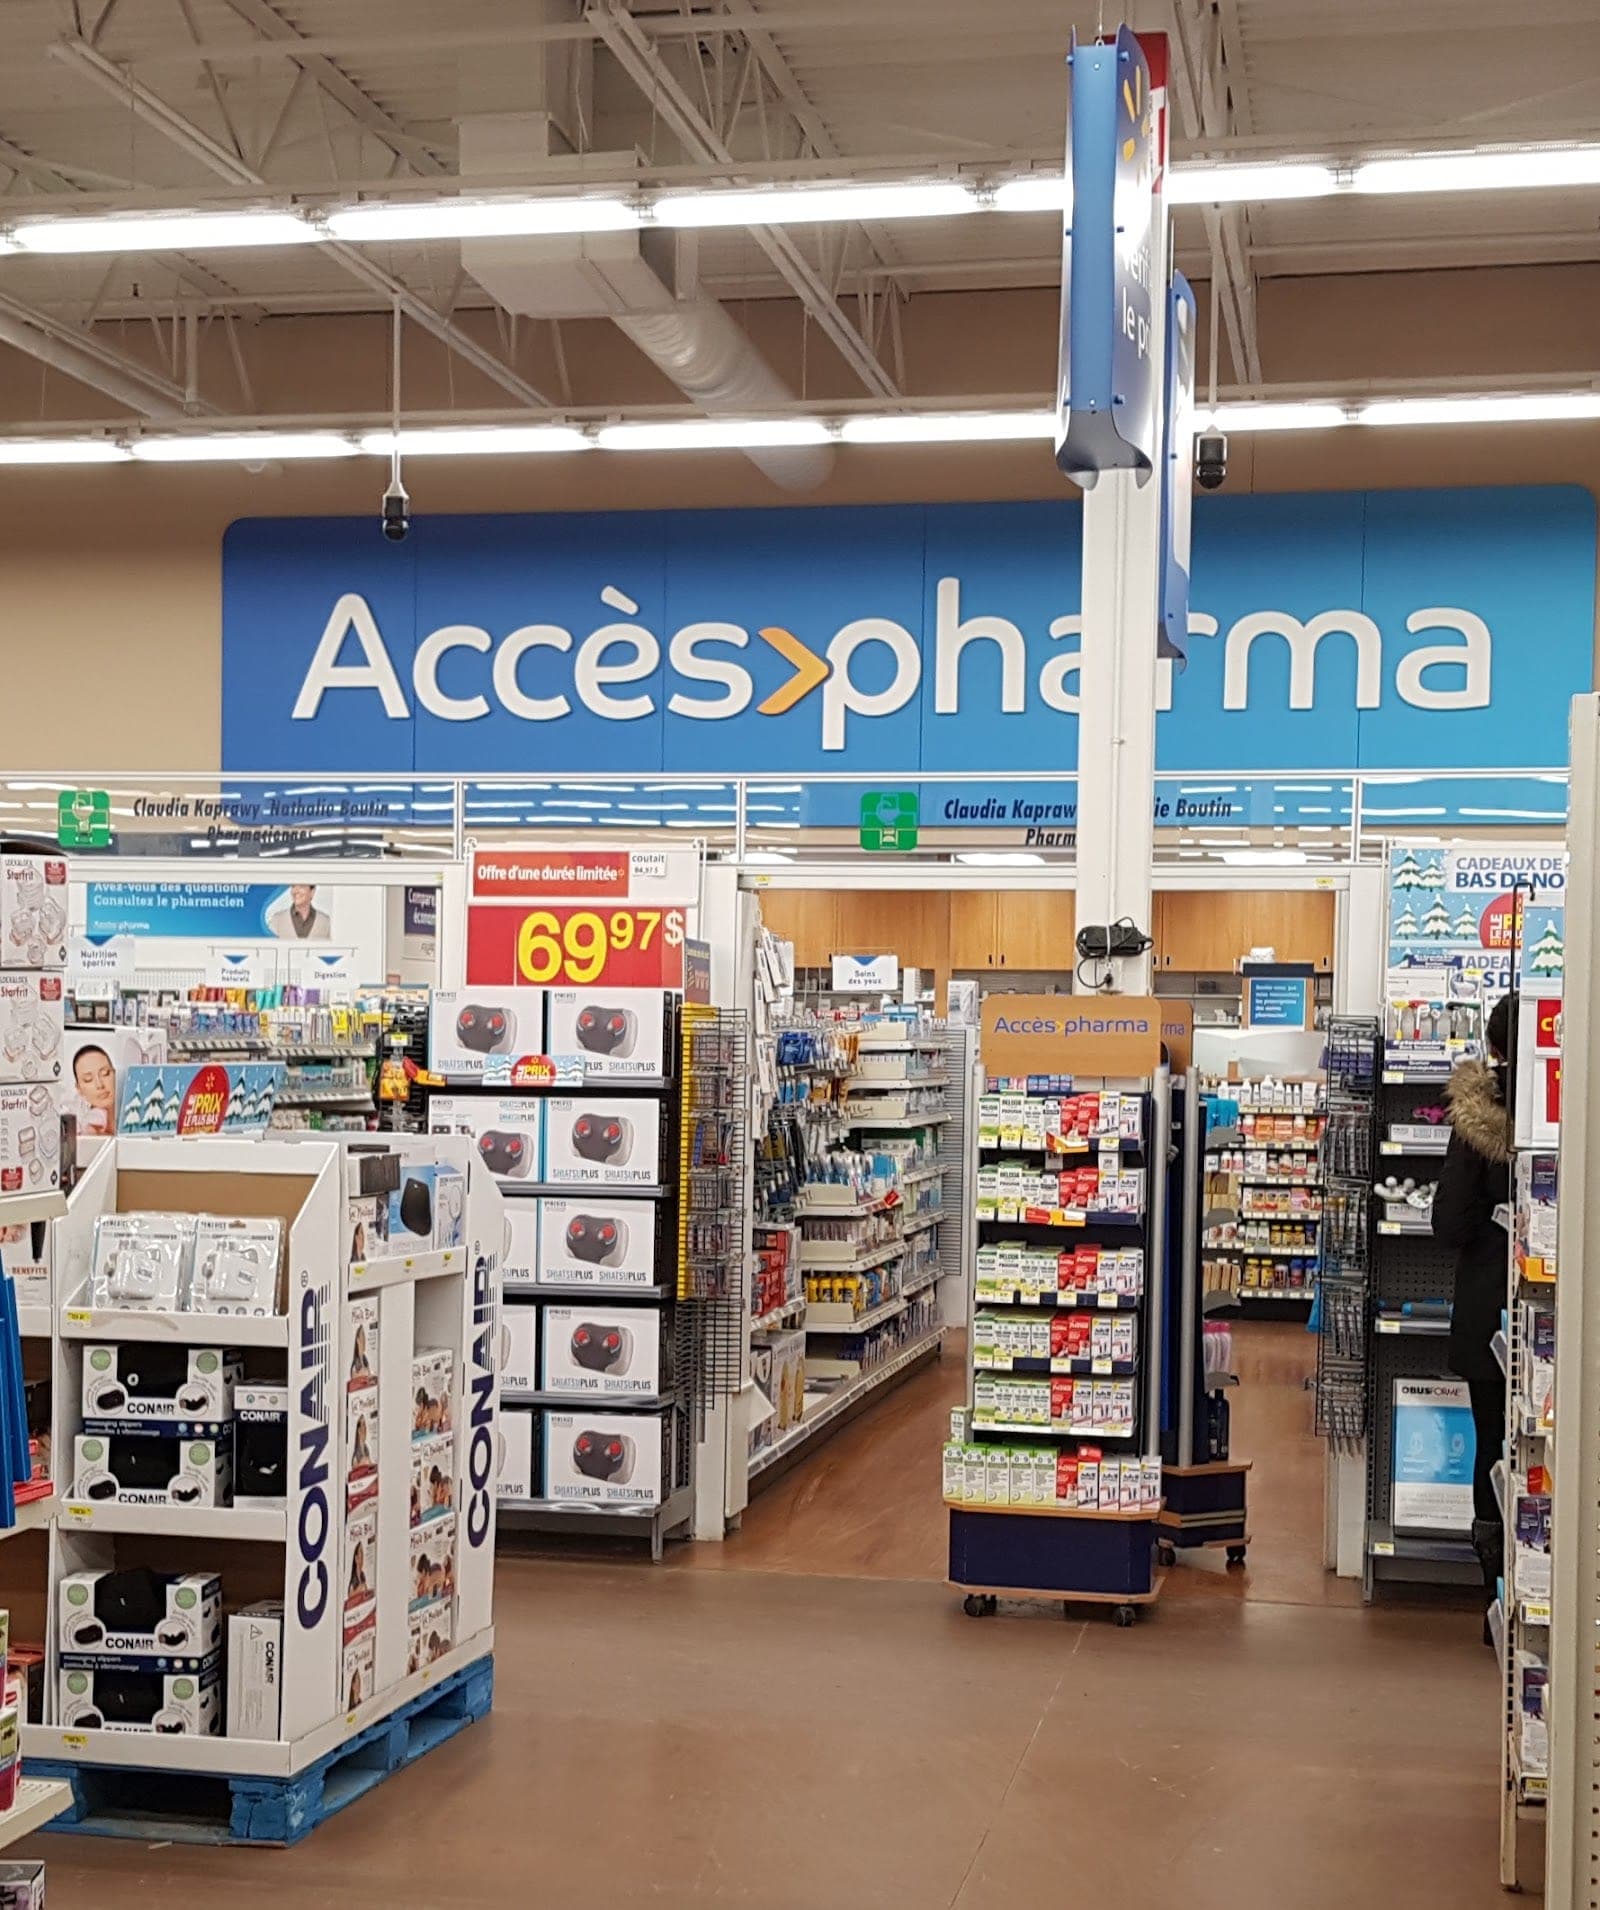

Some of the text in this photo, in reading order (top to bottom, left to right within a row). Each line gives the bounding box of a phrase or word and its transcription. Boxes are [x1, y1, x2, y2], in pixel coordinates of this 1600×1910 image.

[291, 585, 754, 722] Accès
[133, 799, 190, 818] Claudia
[194, 799, 260, 820] Kaprawy
[340, 799, 390, 818] Boutin
[943, 799, 1007, 820] Claudia
[1175, 796, 1233, 818] Boutin
[1456, 857, 1563, 871] CADEAUX DE
[6, 869, 35, 881] Starfrit
[477, 865, 618, 882] Offre d'une durée limitée
[1455, 872, 1498, 888] BAS
[160, 883, 182, 893] des
[93, 894, 245, 909] Consultez le pharmacien
[80, 950, 118, 960] Nutrition
[854, 969, 876, 978] Soins
[0, 987, 29, 999] Starfrit
[993, 1014, 1149, 1038] Accès pharma
[0, 1099, 28, 1111] Starfrit
[194, 1091, 225, 1115] PRIX
[127, 1402, 175, 1415] CONAIR
[467, 1256, 498, 1549] CONAIR
[239, 1410, 281, 1422] CONAIR
[297, 1286, 332, 1632] CONAIR
[118, 1492, 168, 1504] CONAIR
[105, 1637, 154, 1650] CONAIR
[265, 1641, 275, 1684] CONAIR
